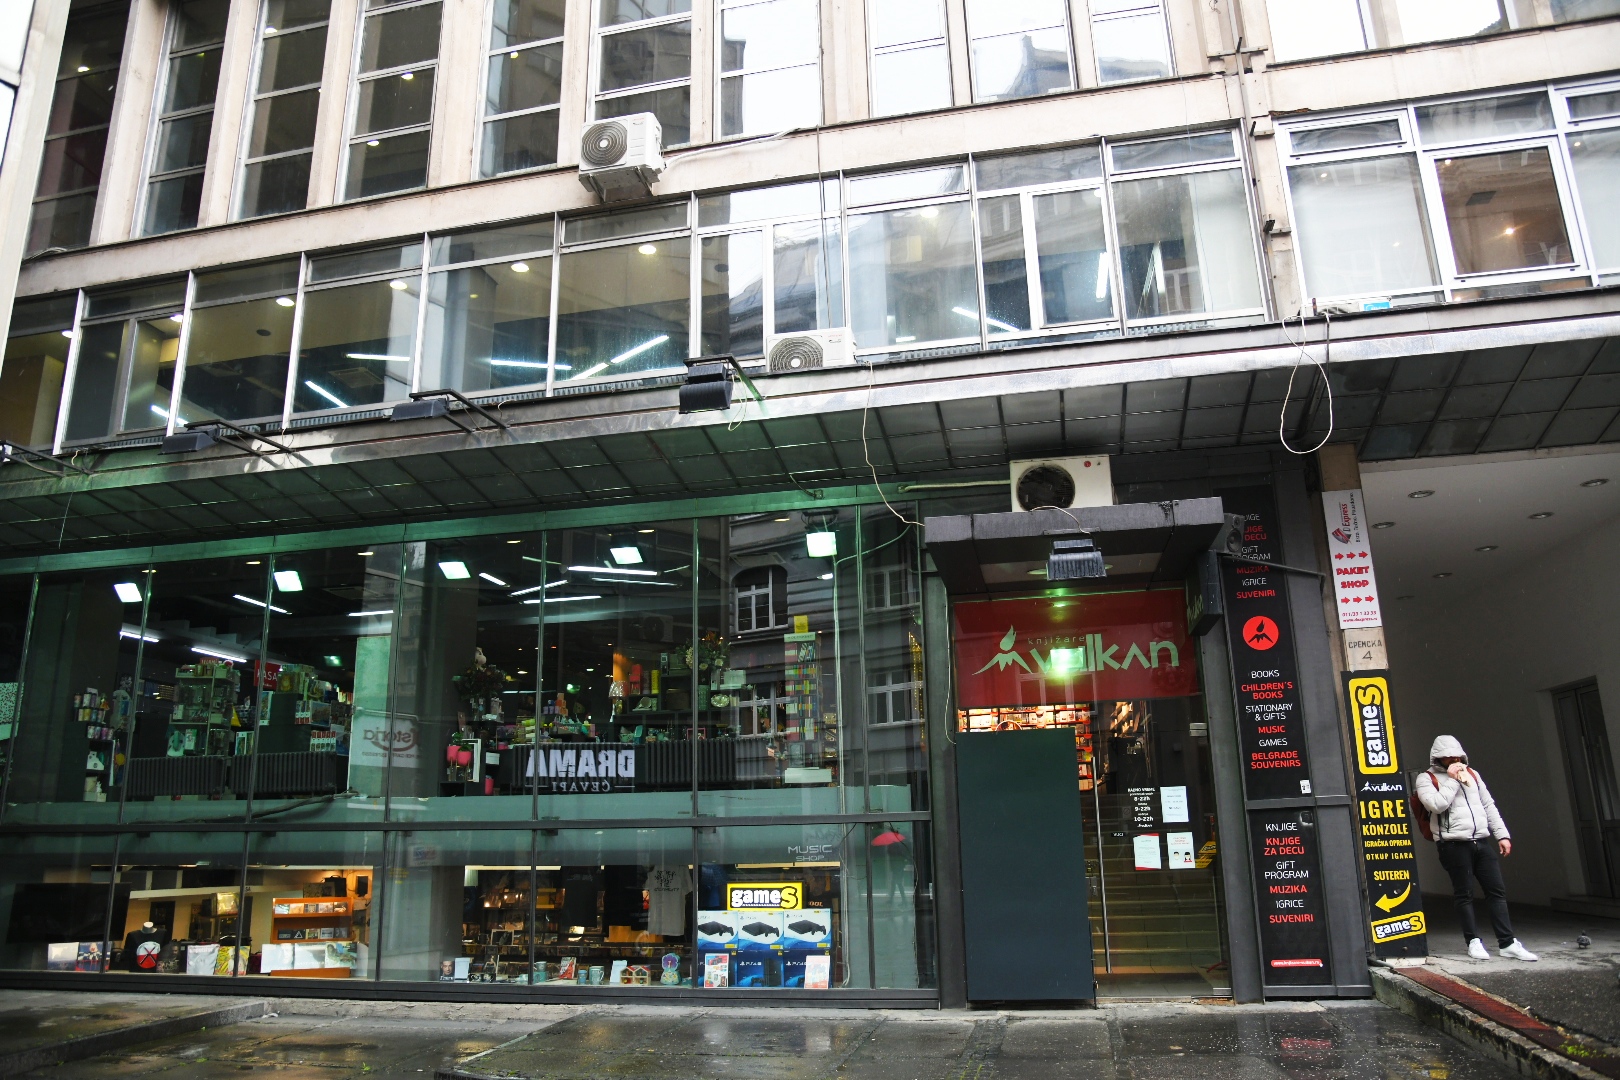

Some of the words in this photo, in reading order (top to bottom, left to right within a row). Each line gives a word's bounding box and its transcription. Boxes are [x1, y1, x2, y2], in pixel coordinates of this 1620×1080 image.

[1244, 525, 1263, 533] JIGE
[1244, 533, 1267, 541] DECU
[1241, 545, 1258, 553] GIFT
[1232, 552, 1271, 562] OGRAM
[1236, 565, 1270, 574] MUZIKA
[1336, 566, 1370, 576] PAKET
[1242, 577, 1267, 586] IGRICE
[1340, 580, 1370, 589] SHOP
[1236, 589, 1276, 599] SUVENIRI
[1027, 635, 1085, 646] knjižare
[1348, 640, 1383, 649] СРЕМСКА
[1362, 650, 1373, 661] 4
[1250, 669, 1280, 678] BOOKS
[1241, 681, 1293, 692] CHILDREN'S
[1252, 690, 1284, 700] BOOKS
[1245, 703, 1293, 713] STATIONARY
[1254, 713, 1261, 721] &
[1262, 712, 1287, 721] GIFTS
[1258, 725, 1286, 734] MUSIC
[1258, 738, 1288, 747] GAMES
[1251, 751, 1299, 760] BELGRADE
[1250, 760, 1302, 769] SOUVENIRS
[1371, 782, 1403, 792] vulkan
[1359, 799, 1406, 819] IGRE
[1265, 822, 1298, 832] KNJIGE
[1362, 823, 1409, 836] KONZOLE
[1265, 836, 1301, 846] KNJIGE
[1389, 839, 1412, 847] OPREMA
[787, 844, 833, 854] MUSIC
[1264, 847, 1277, 856] ZA
[1279, 846, 1305, 855] DECU
[1365, 853, 1389, 861] OTKUP
[1391, 852, 1414, 860] IGARA
[1275, 860, 1296, 870] GIFT
[1264, 870, 1309, 880] PROGRAM
[1373, 869, 1410, 881] SUTEREN
[1269, 884, 1308, 894] MUZIKA
[1275, 899, 1305, 909] IGRICE
[1269, 913, 1314, 924] SUVENIRI
